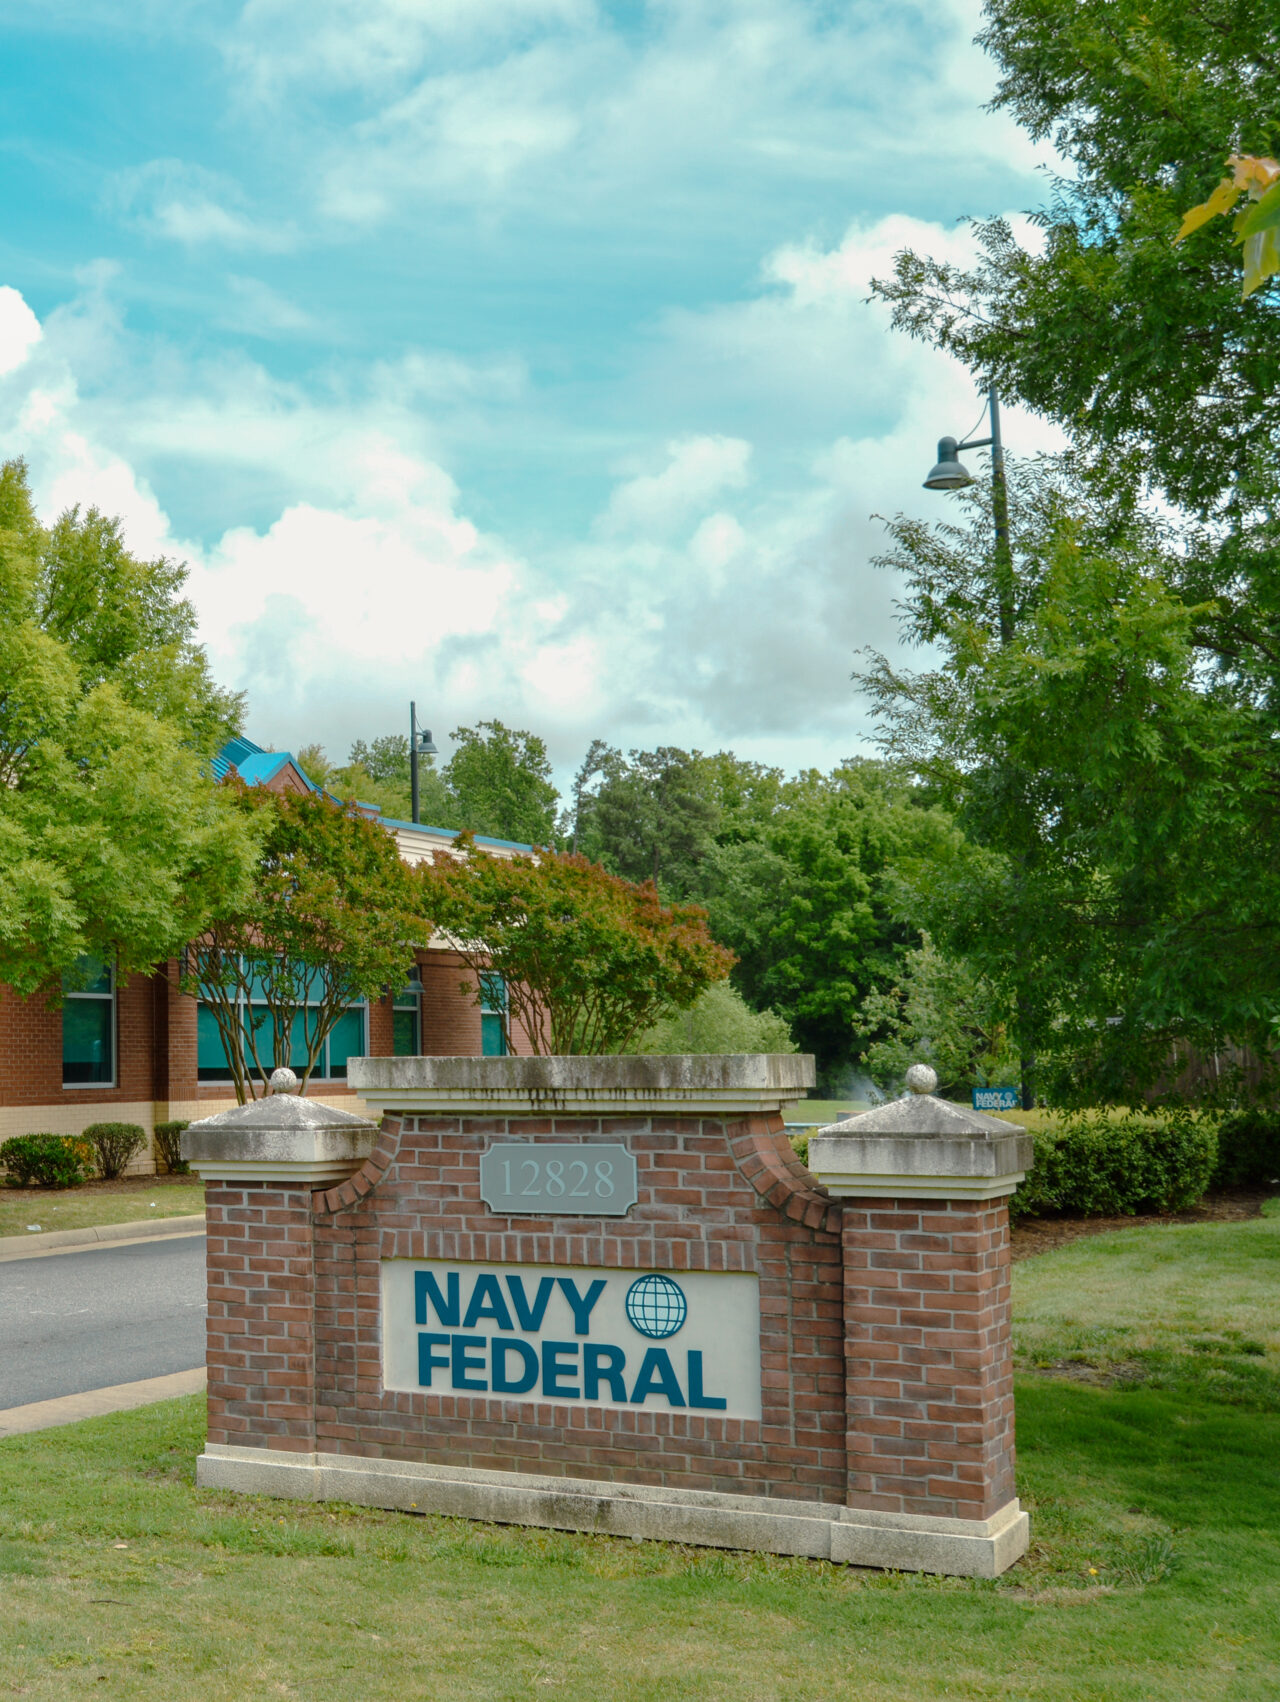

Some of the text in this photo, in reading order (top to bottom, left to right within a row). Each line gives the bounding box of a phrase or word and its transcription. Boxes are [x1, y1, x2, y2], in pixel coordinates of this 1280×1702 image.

[975, 1092, 1003, 1101] NAVY
[499, 1159, 615, 1198] 12828
[414, 1270, 607, 1335] NAVY
[418, 1332, 727, 1410] FEDERAL
